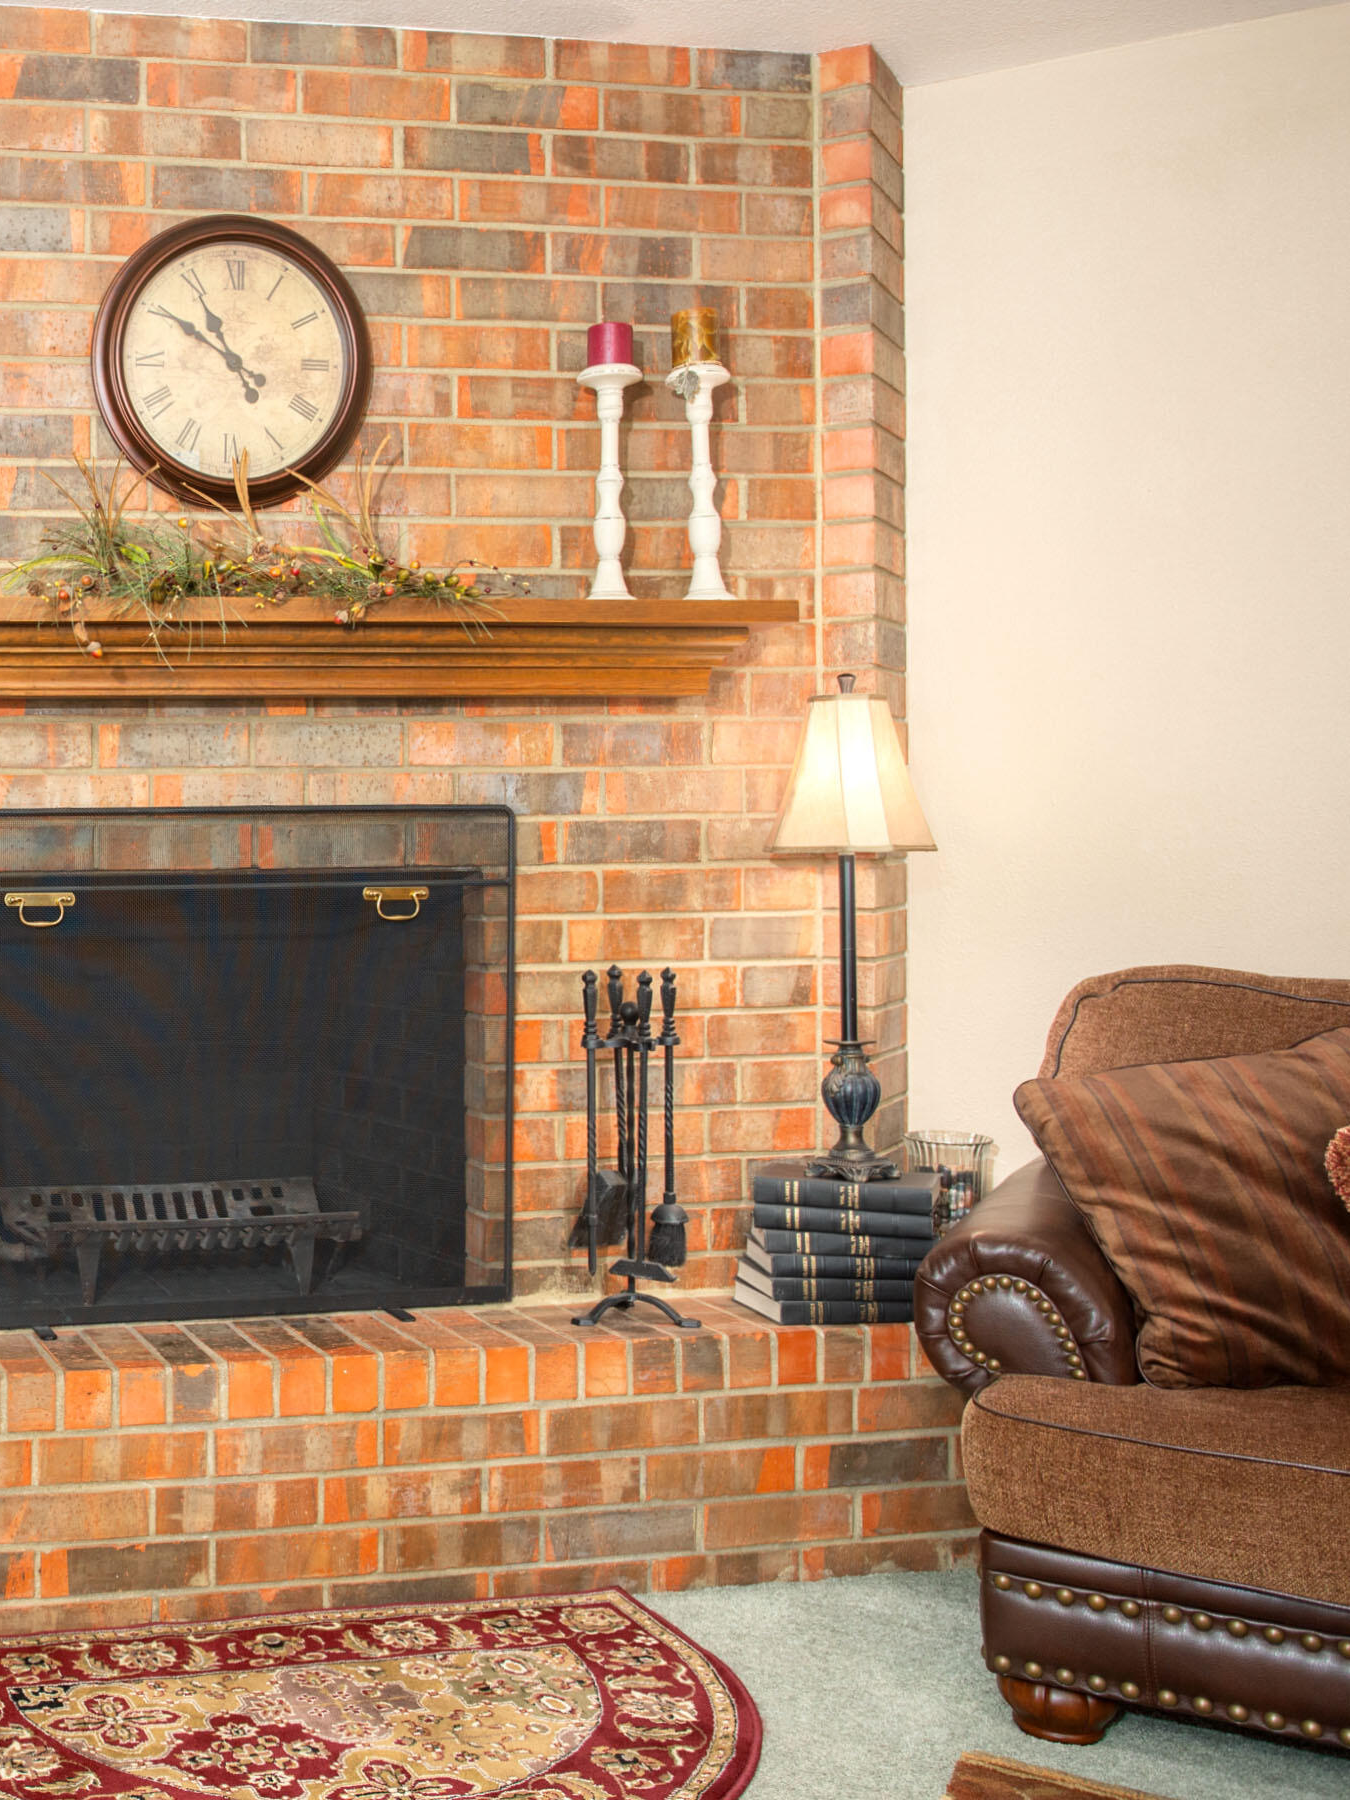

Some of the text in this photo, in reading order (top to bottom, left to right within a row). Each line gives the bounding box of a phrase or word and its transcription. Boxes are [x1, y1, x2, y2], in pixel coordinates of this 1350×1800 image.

[222, 259, 245, 291] XII
[290, 311, 319, 330] II
[300, 358, 330, 373] III
